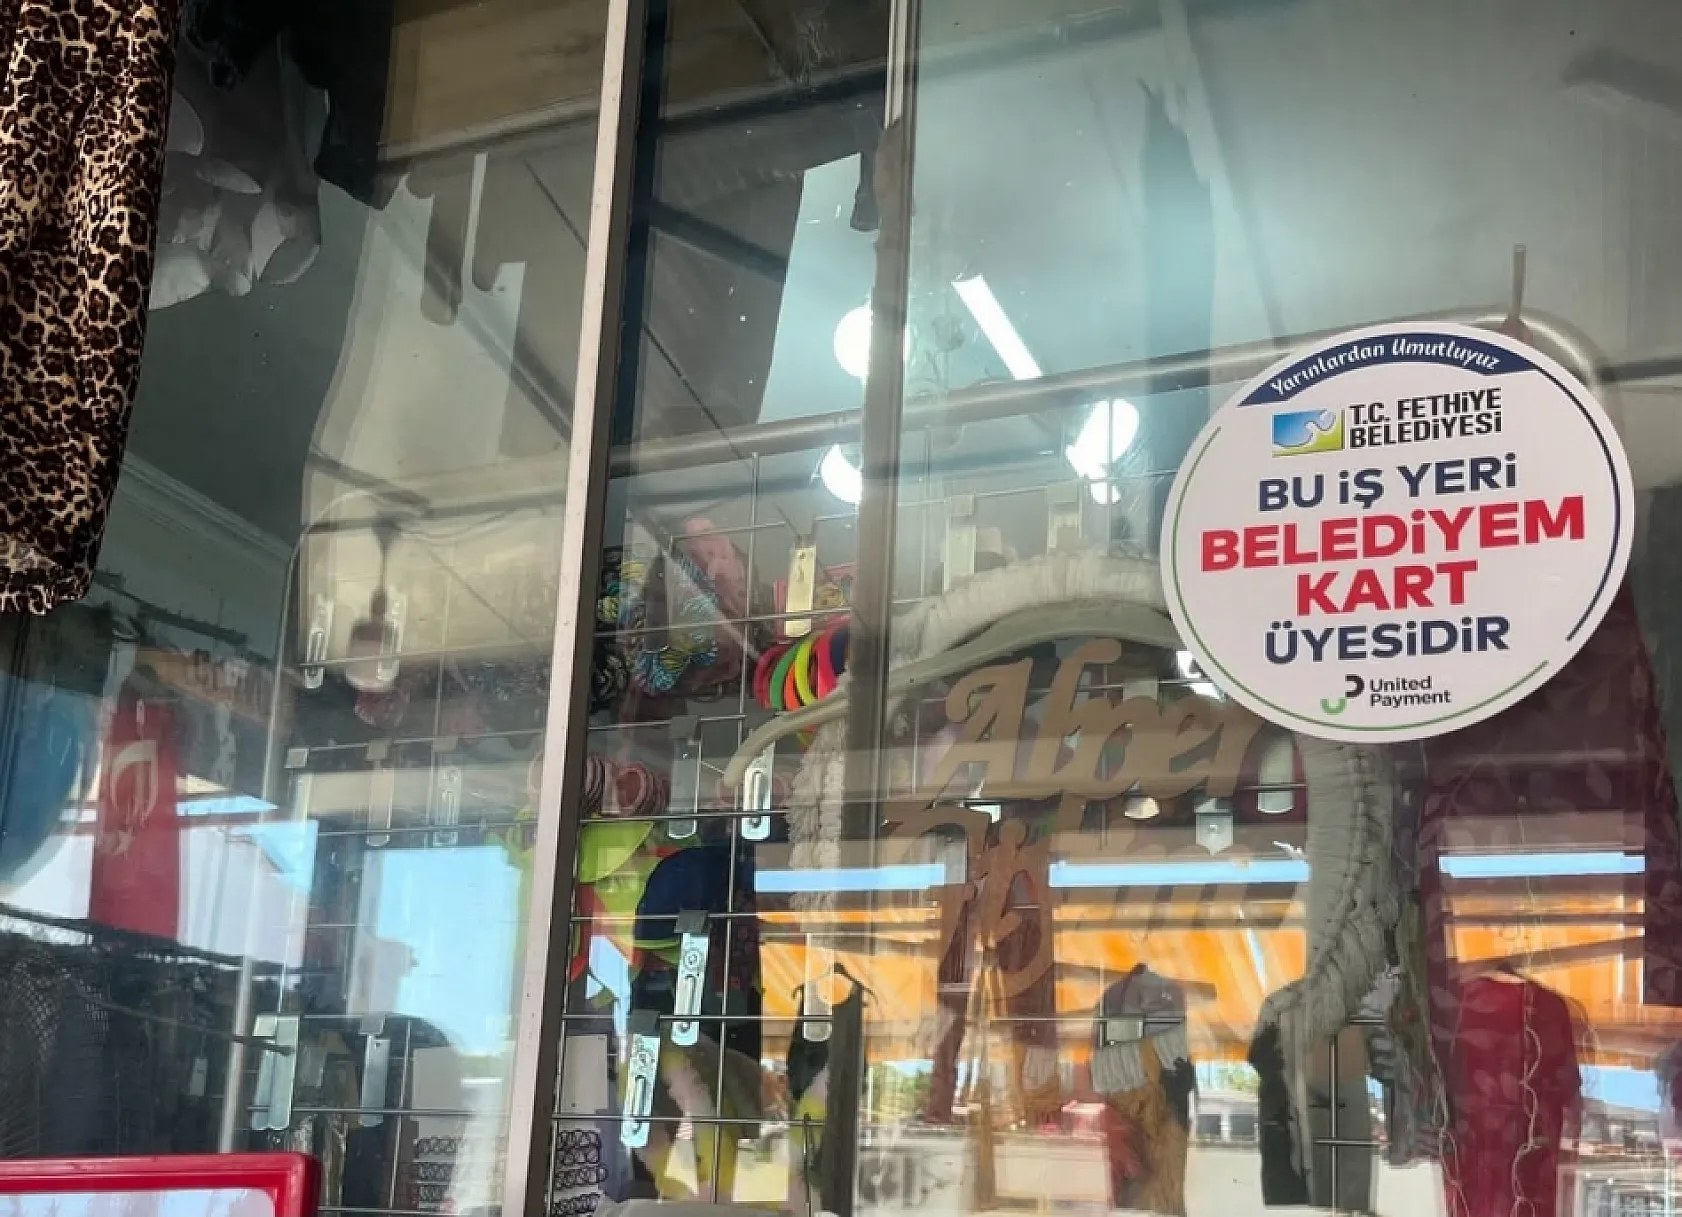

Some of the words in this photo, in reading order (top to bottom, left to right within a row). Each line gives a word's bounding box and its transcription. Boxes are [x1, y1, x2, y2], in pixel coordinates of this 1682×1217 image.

[1392, 338, 1500, 370] Umutluyuz
[1349, 402, 1390, 425] T.C.
[1259, 474, 1324, 512] BU
[1297, 560, 1477, 616] KART
[1369, 675, 1432, 693] United
[1369, 690, 1452, 708] Payment
